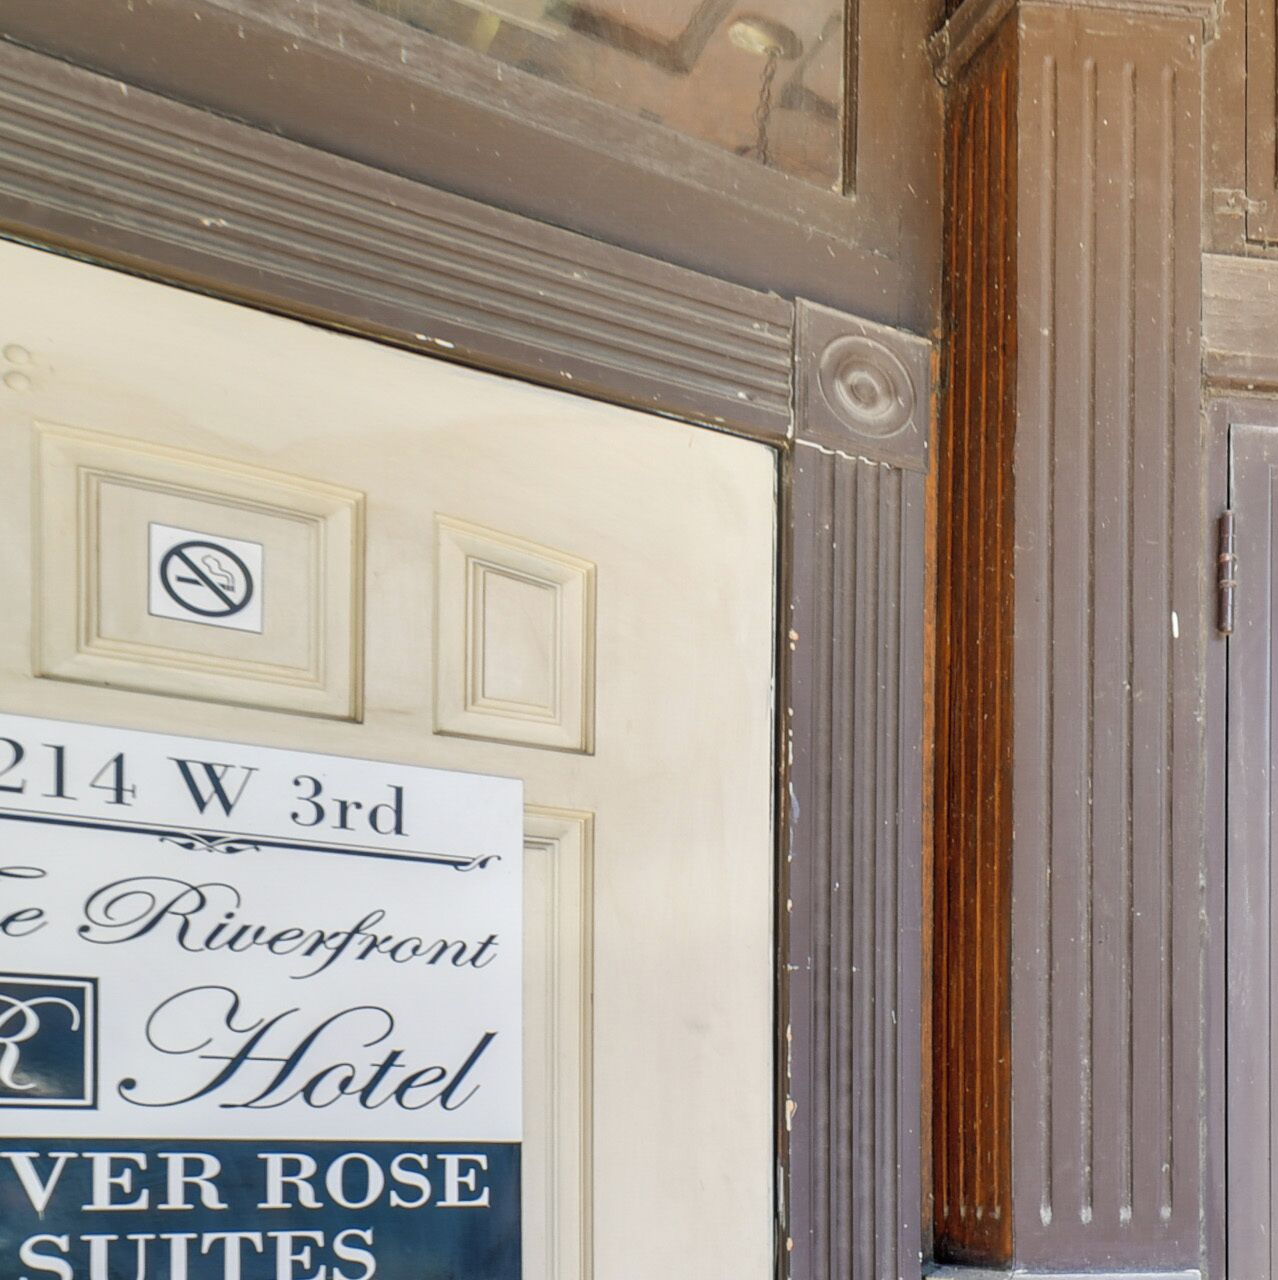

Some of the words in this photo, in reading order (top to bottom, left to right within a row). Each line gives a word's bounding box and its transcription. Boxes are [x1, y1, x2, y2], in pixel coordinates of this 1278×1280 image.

[0, 737, 137, 806] 214
[168, 756, 260, 818] W
[290, 774, 411, 838] 3rd
[77, 875, 501, 980] Riverfront
[117, 984, 501, 1112] Hotel
[0, 1151, 229, 1213] VER
[256, 1152, 492, 1211] ROSE
